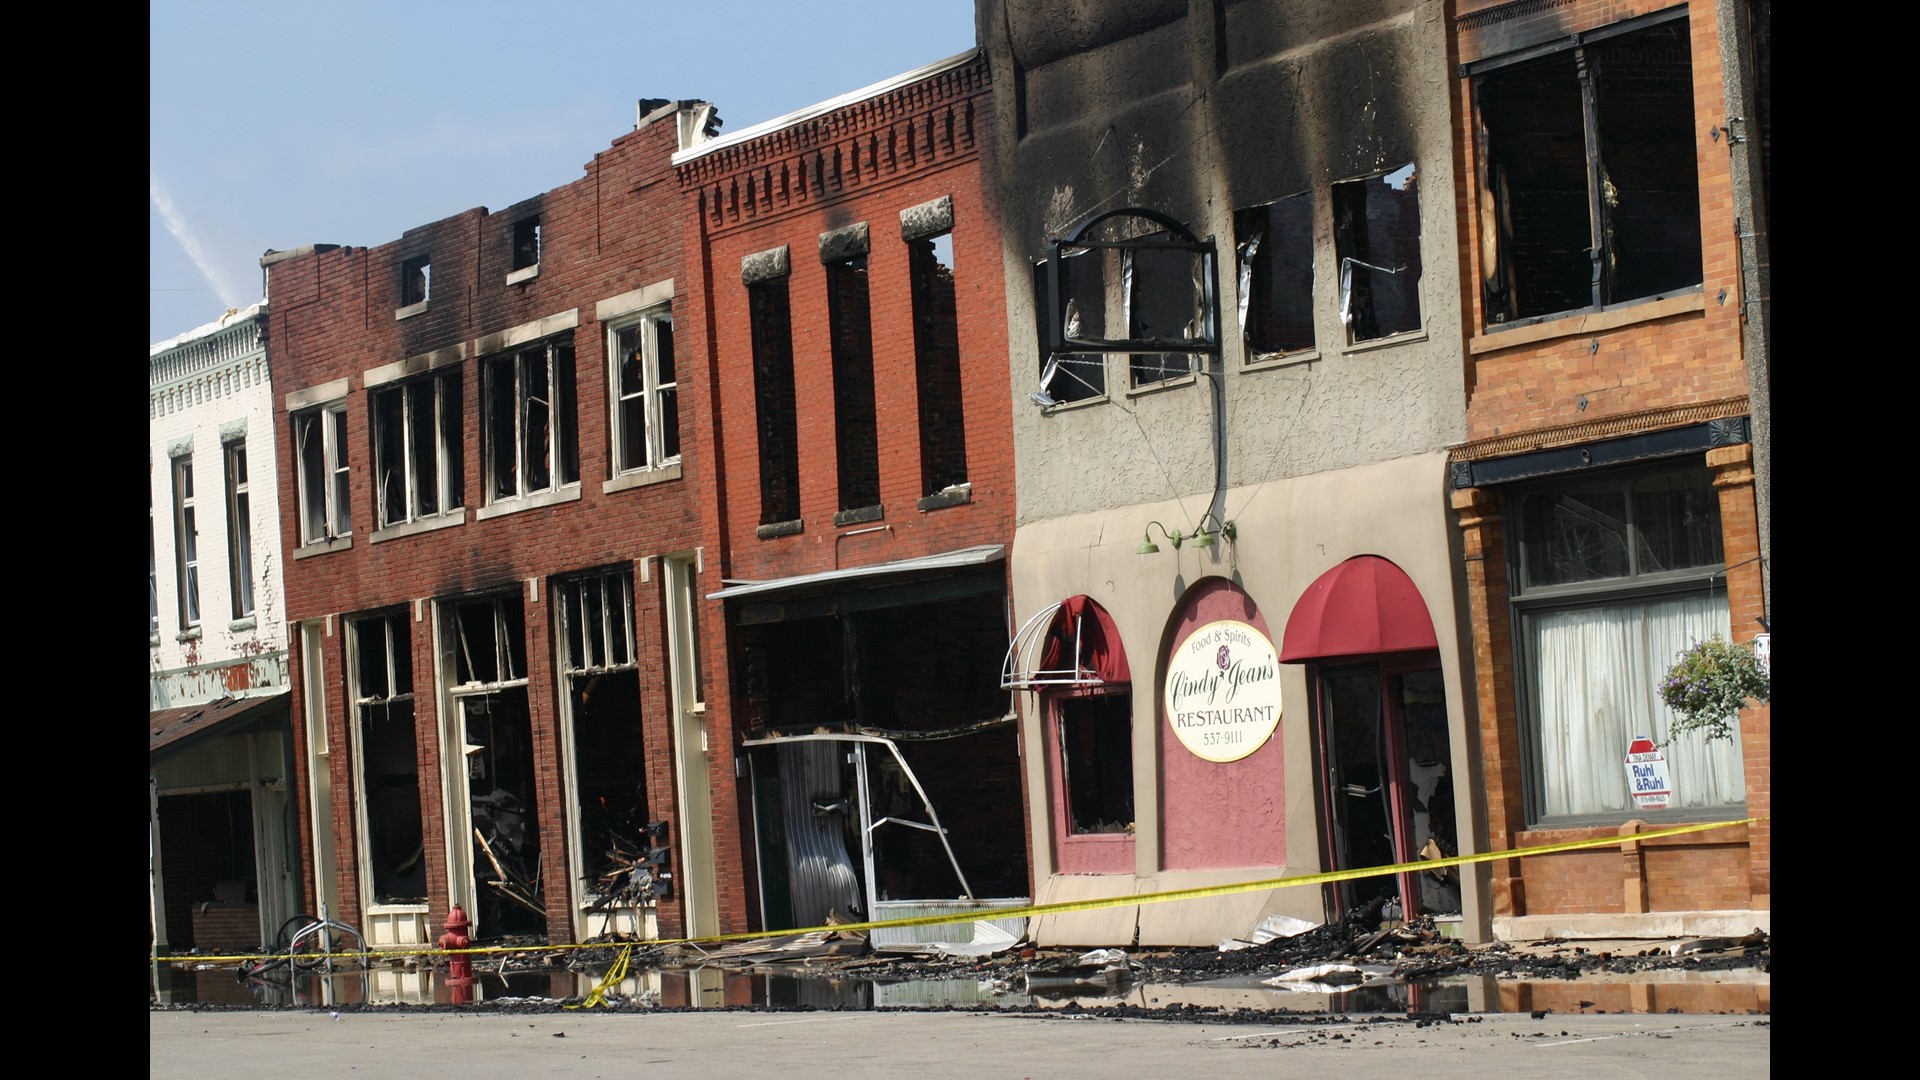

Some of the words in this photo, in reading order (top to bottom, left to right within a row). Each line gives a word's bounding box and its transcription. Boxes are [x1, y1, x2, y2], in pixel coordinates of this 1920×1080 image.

[1191, 632, 1212, 654] Food
[1214, 630, 1222, 642] &
[1224, 628, 1251, 647] Spirits
[1170, 668, 1220, 712] Cindy
[1225, 653, 1274, 704] Jean's
[1177, 705, 1274, 728] RESTAURANT
[1203, 730, 1243, 746] 537-9111
[1632, 764, 1654, 777] Ruhl
